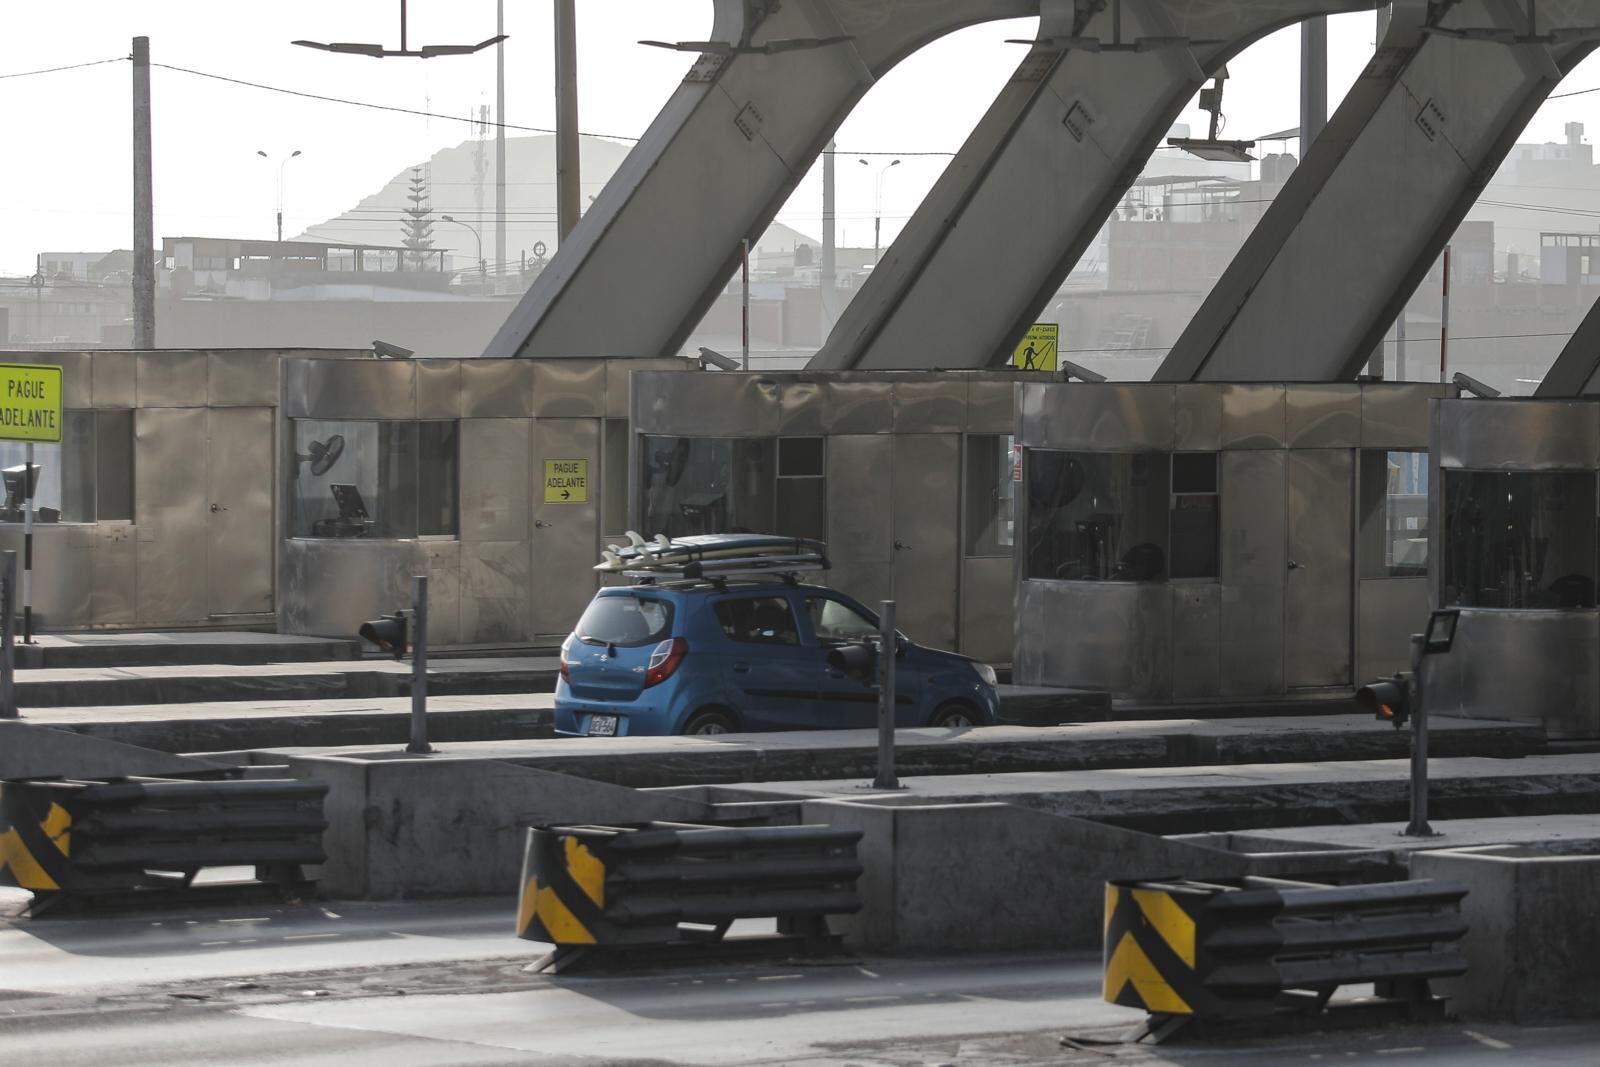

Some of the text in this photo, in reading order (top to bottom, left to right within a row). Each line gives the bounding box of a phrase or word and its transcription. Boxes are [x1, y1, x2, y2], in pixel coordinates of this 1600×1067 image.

[8, 380, 45, 399] PAGUE
[0, 408, 55, 428] ADELANTE
[554, 463, 579, 473] PAGUE
[547, 477, 585, 488] ADELANTE
